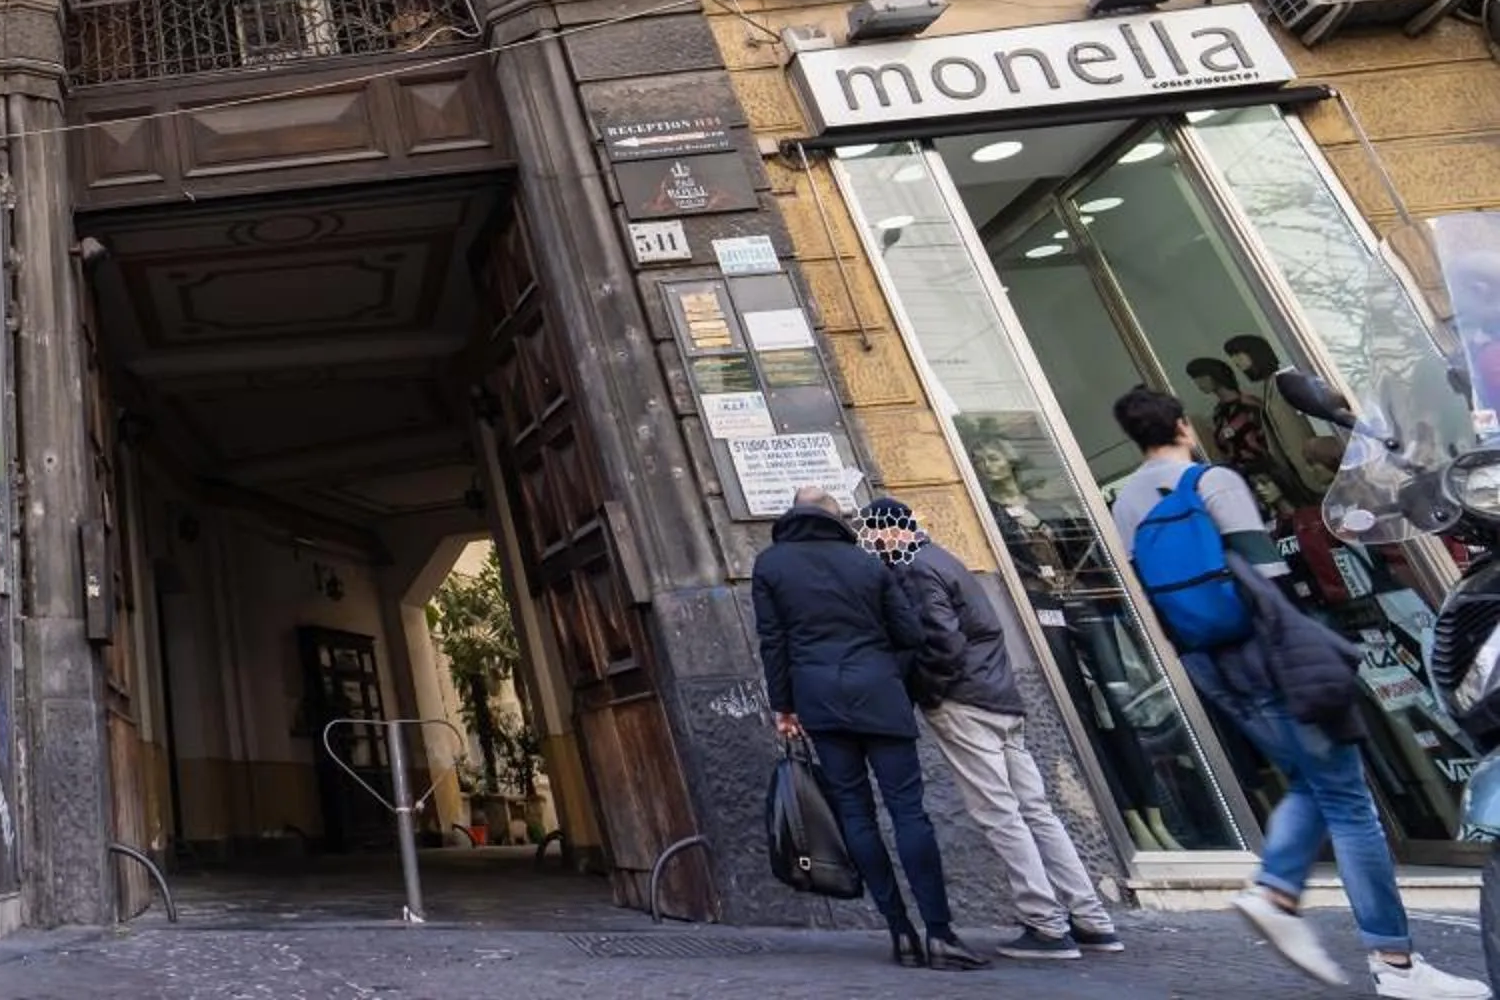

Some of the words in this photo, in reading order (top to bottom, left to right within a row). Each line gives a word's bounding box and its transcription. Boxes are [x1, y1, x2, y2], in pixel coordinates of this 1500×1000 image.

[835, 20, 1256, 110] monella
[607, 119, 691, 136] RECEPTION
[733, 439, 770, 453] STUDIO
[771, 435, 831, 450] DENTISTICO
